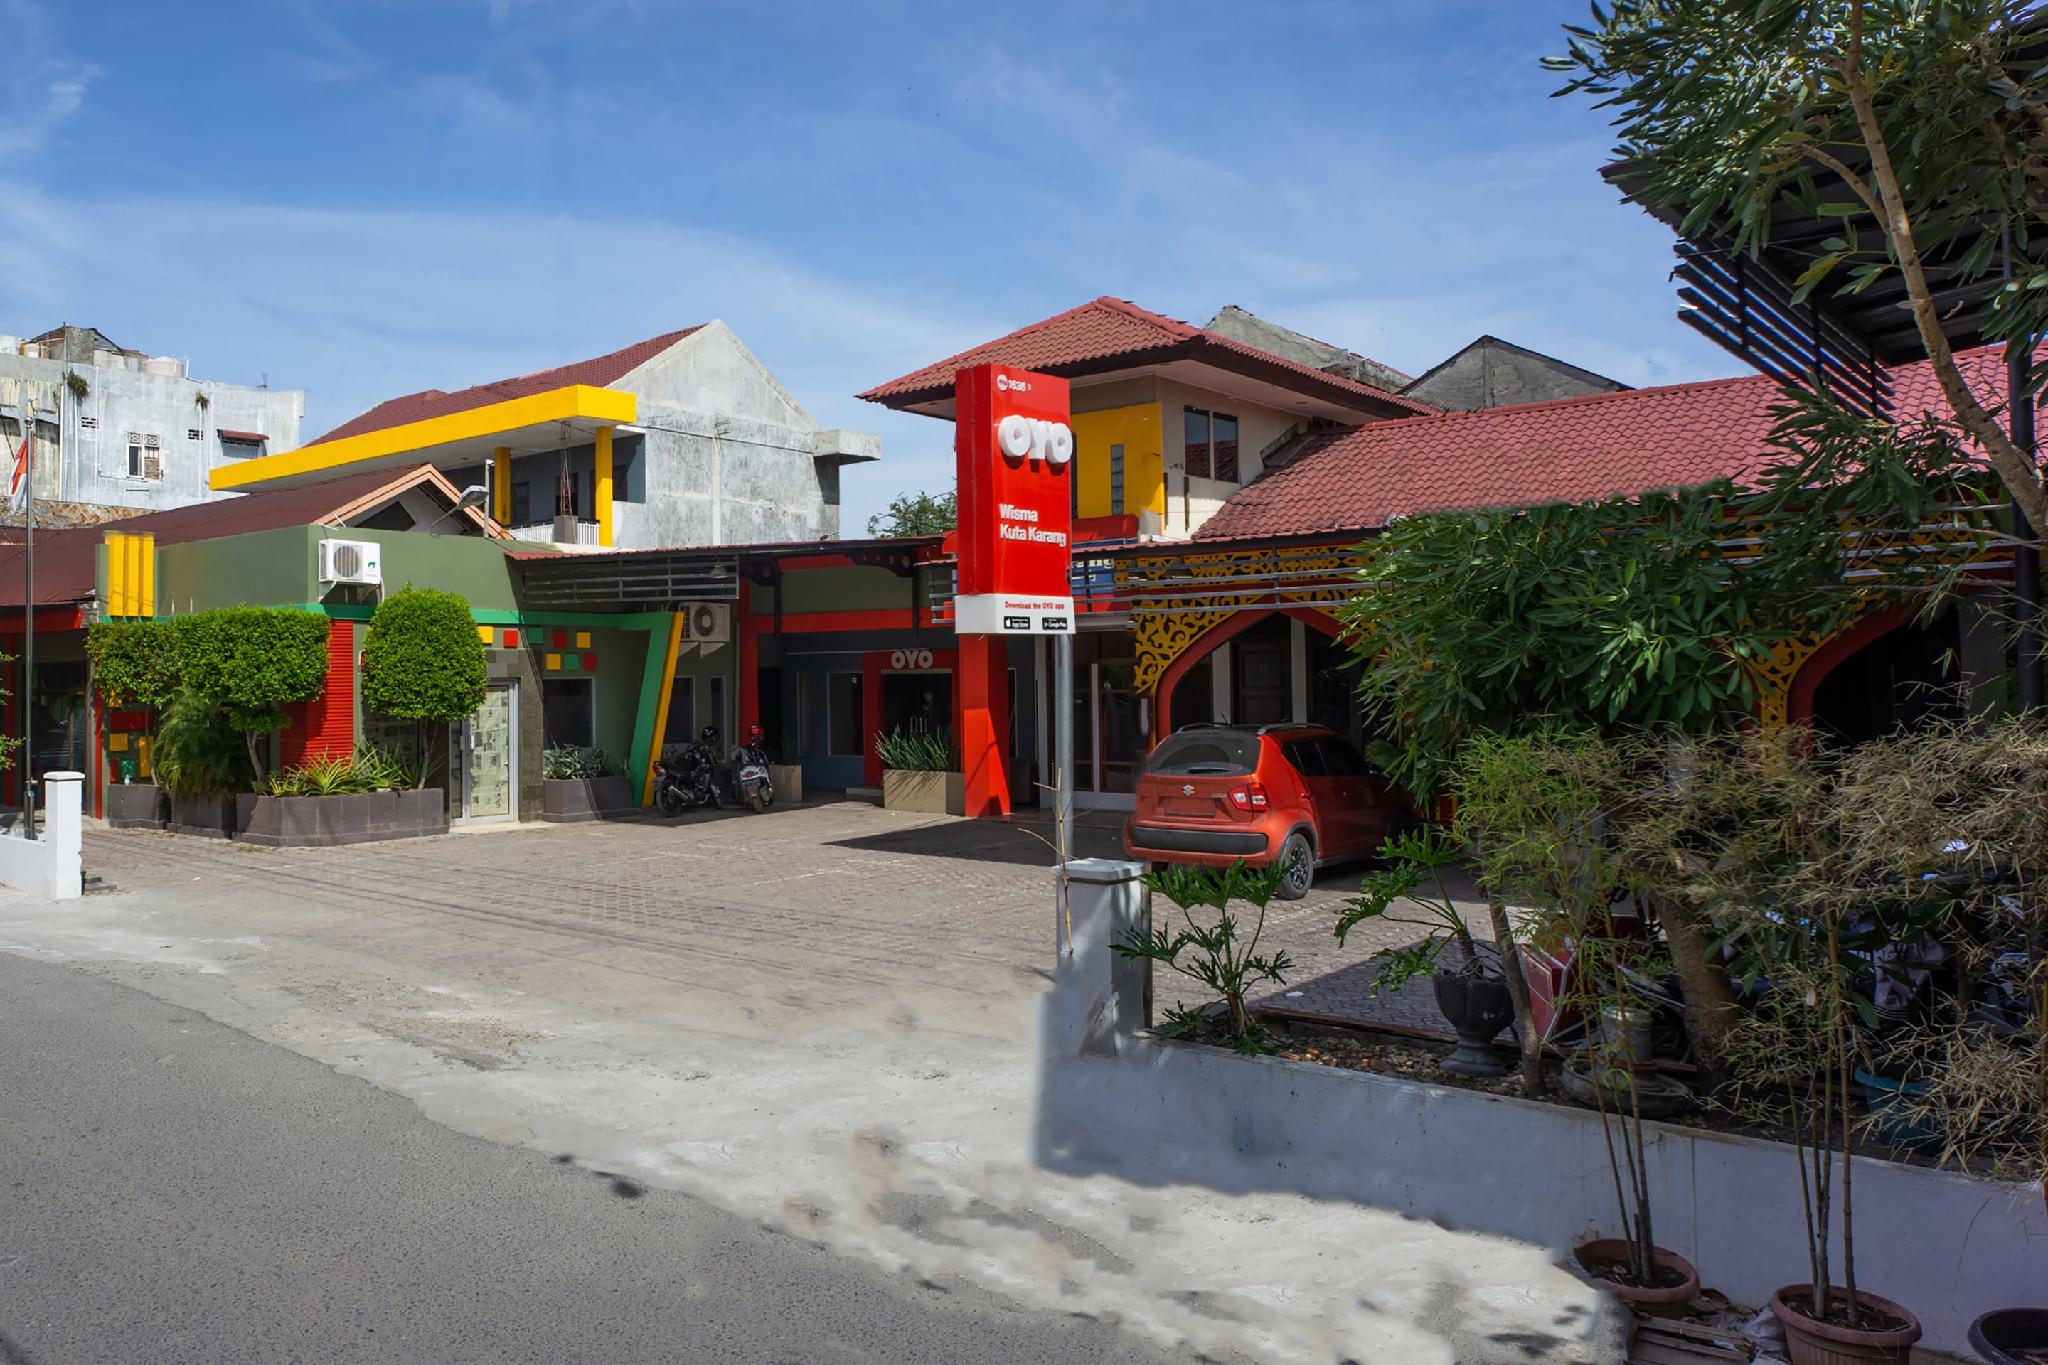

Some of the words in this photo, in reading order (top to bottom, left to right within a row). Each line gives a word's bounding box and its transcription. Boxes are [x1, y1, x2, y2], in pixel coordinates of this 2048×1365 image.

[998, 414, 1073, 464] OYO
[999, 504, 1038, 522] Wisma
[1000, 524, 1027, 541] Kuta
[1028, 526, 1066, 547] Karang
[891, 650, 933, 669] OYO
